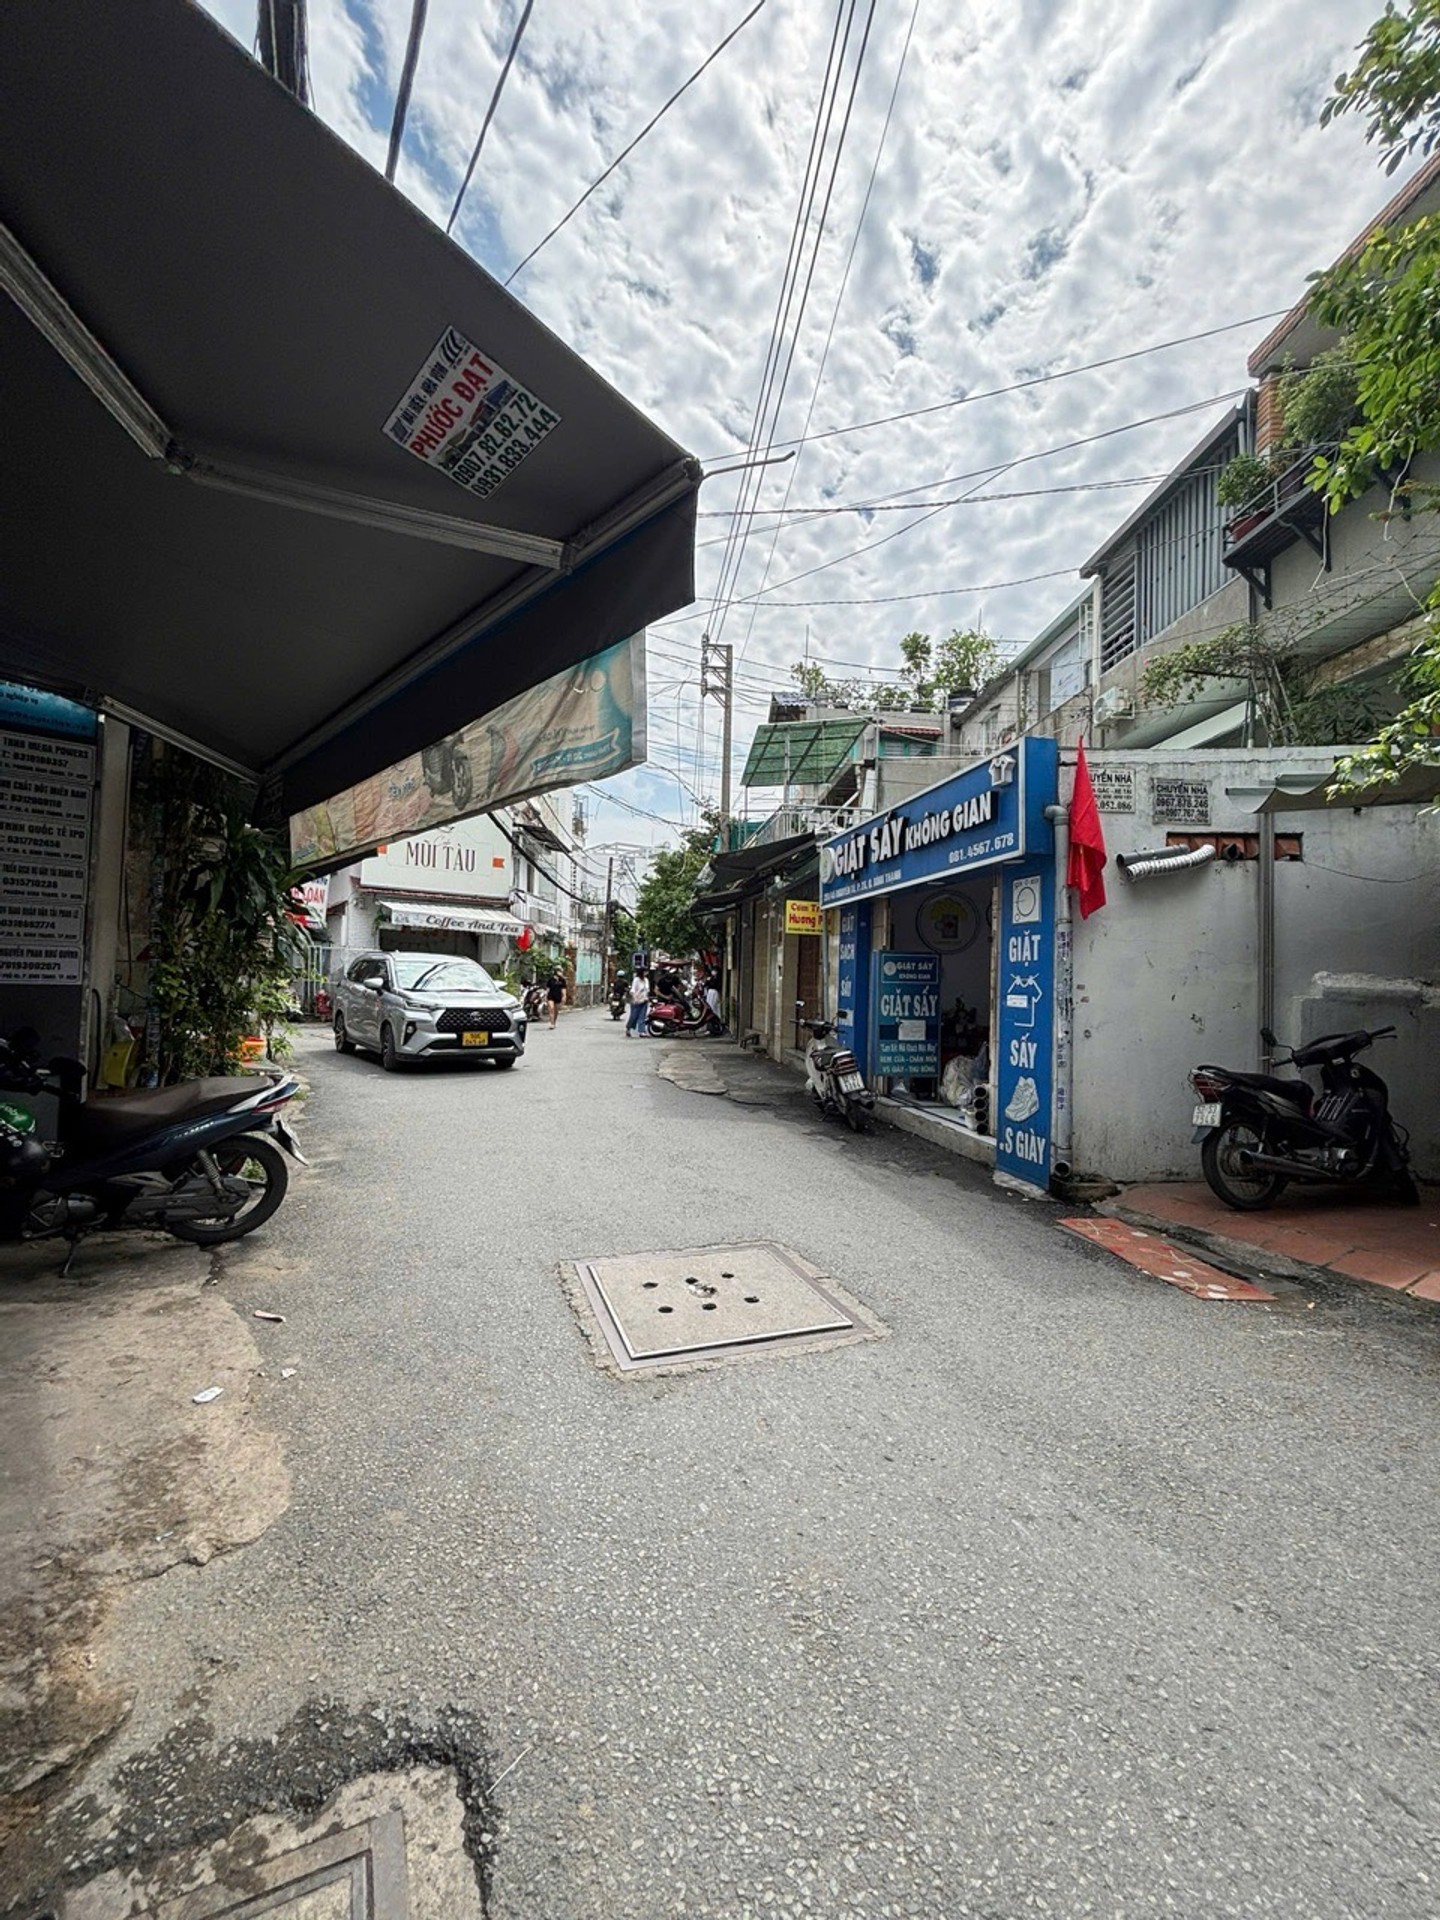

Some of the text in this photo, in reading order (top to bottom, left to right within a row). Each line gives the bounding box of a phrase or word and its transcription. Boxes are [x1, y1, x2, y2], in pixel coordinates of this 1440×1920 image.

[408, 351, 495, 459] PHƯỚC ĐẠT
[450, 390, 539, 486] 0907.82.62.72
[470, 406, 557, 498] 0931.833.444
[1090, 769, 1133, 784] UYỂN NHÀ
[1156, 781, 1189, 794] CHUYỂN
[1190, 784, 1209, 796] NHÀ
[870, 811, 904, 864] SẤY
[905, 811, 951, 852] KHÔNG
[952, 790, 992, 833] GIAN
[443, 843, 475, 872] TÀU
[948, 832, 1014, 864] 081.4567.678
[425, 915, 519, 933] Coffee And Tea
[1008, 930, 1041, 967] GIẶT
[881, 988, 912, 1023] GIẶT
[913, 985, 938, 1017] SẤY
[1010, 1032, 1038, 1069] SẤY
[1016, 1128, 1046, 1165] GIÀY
